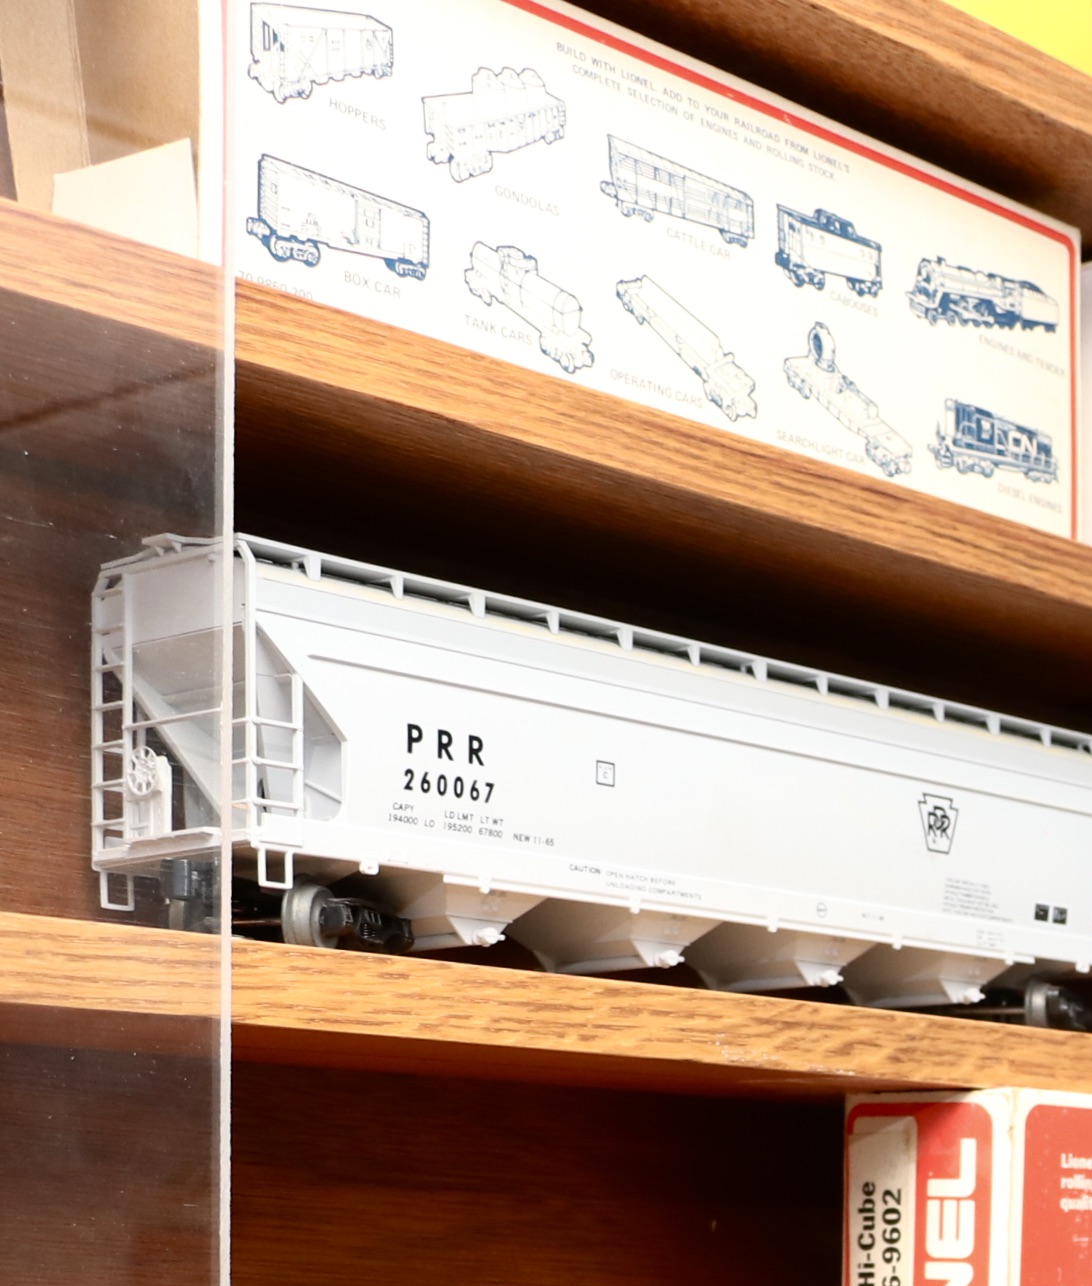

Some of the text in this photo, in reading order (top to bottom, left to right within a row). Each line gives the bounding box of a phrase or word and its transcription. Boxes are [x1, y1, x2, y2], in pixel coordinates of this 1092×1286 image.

[328, 97, 388, 131] HOPPERS
[556, 41, 587, 62] BUILD
[591, 53, 616, 74] WITH
[662, 86, 684, 103] ADD
[687, 96, 700, 110] TO
[704, 103, 730, 122] YOUR
[734, 116, 781, 143] RAILROAD
[784, 137, 810, 156] FROM
[572, 63, 805, 169] COMPLETE SELECTION OF ENGINES AND ROLLING
[494, 184, 560, 217] GONDOLAS
[666, 226, 732, 261] CATTLE CAR
[344, 269, 402, 300] BOX CAR
[830, 290, 879, 318] CABOOSES
[463, 313, 533, 347] TANK CARS
[609, 367, 703, 409] OPERATING CARS
[776, 429, 866, 466] SEARCHLIGHT CAR
[407, 723, 486, 768] PRR
[403, 768, 496, 805] 260067
[392, 801, 416, 814] CAPY
[388, 813, 531, 844] 194000 195200 67800 NEW
[606, 880, 648, 894] UNLOADING
[650, 876, 677, 888] BEFORE
